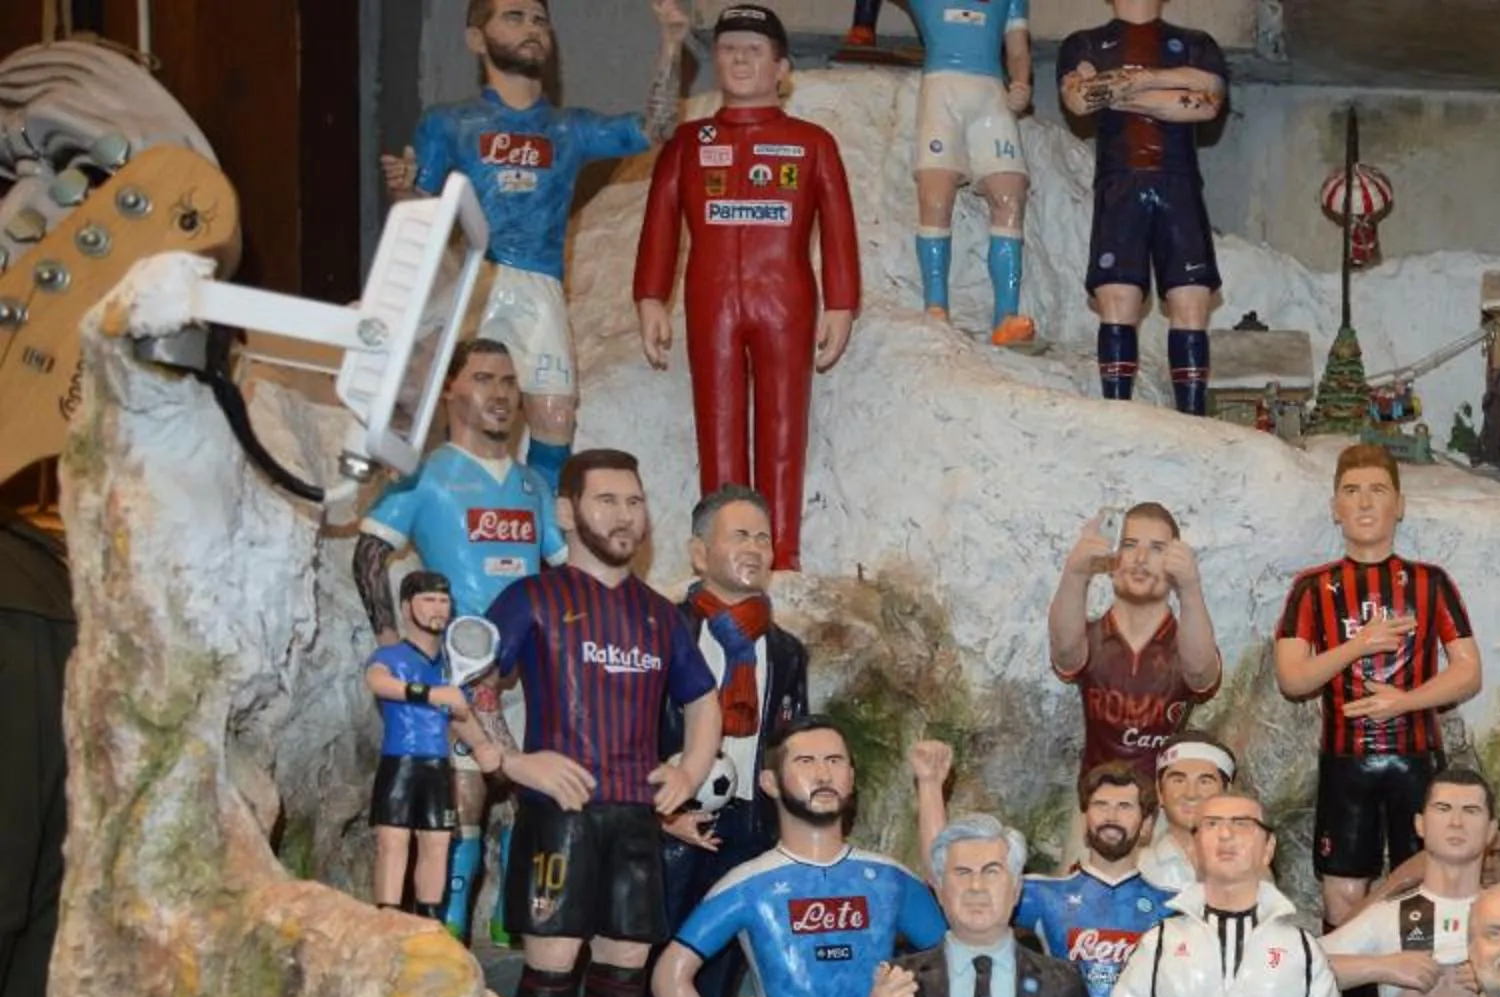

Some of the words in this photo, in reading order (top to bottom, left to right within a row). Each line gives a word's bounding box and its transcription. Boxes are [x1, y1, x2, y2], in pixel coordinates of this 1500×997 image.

[582, 640, 662, 673] Rakuten
[532, 853, 567, 889] 10
[792, 901, 864, 931] Lete
